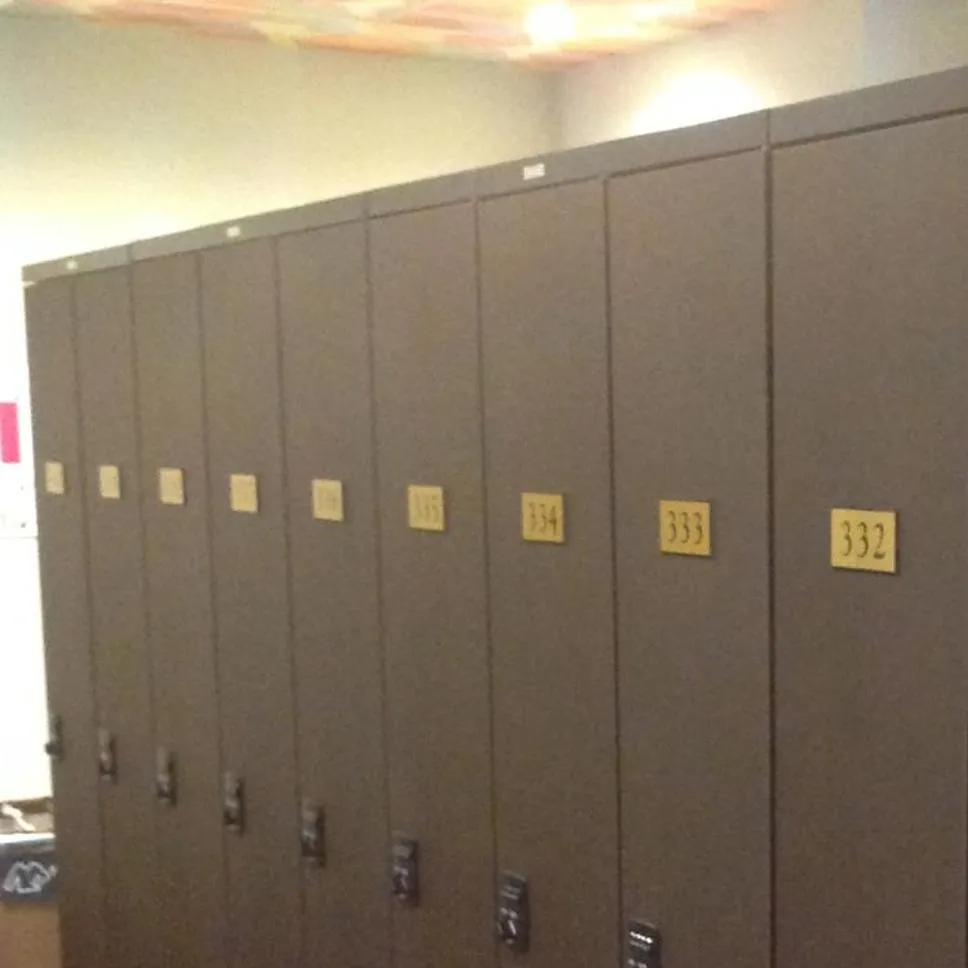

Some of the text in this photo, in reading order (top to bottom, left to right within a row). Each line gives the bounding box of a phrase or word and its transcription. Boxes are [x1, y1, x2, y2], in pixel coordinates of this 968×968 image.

[528, 501, 558, 537] 334
[667, 510, 704, 546] 333
[841, 520, 886, 560] 332
